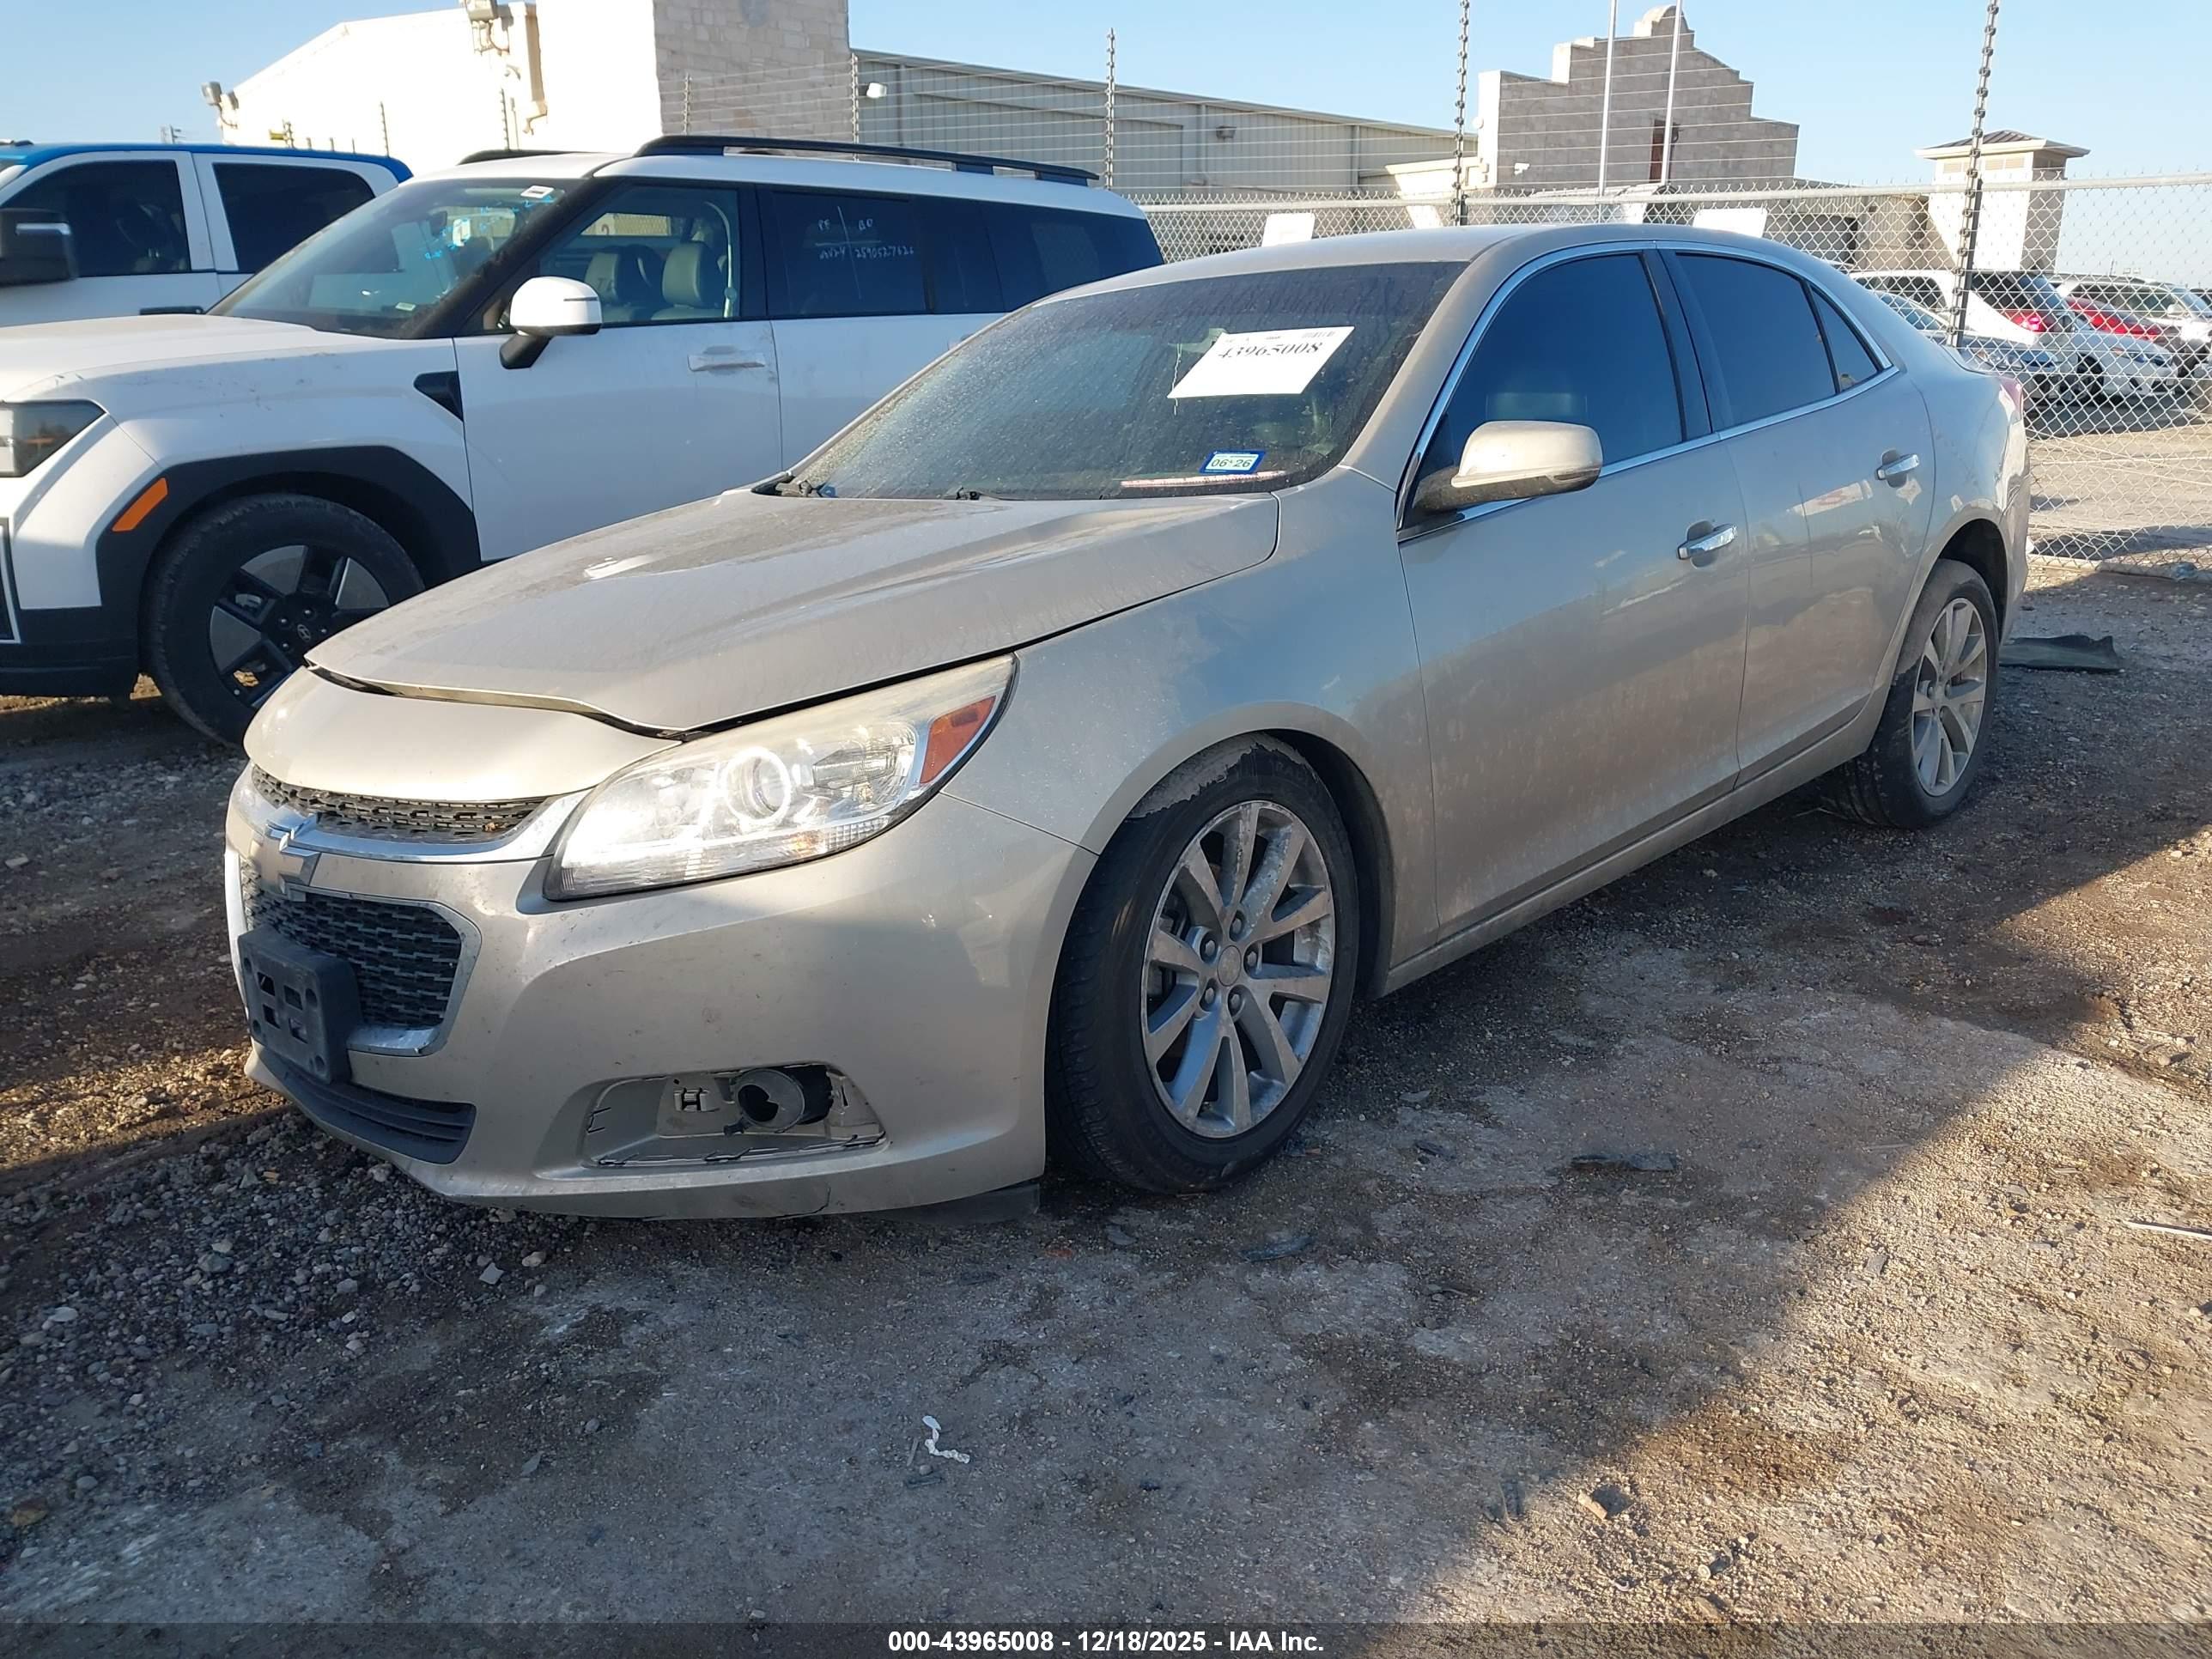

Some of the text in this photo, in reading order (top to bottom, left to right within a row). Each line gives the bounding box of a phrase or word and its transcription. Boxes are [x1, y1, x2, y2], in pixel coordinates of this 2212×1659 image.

[1218, 341, 1323, 358] 43965008
[1211, 459, 1253, 468] 06 26
